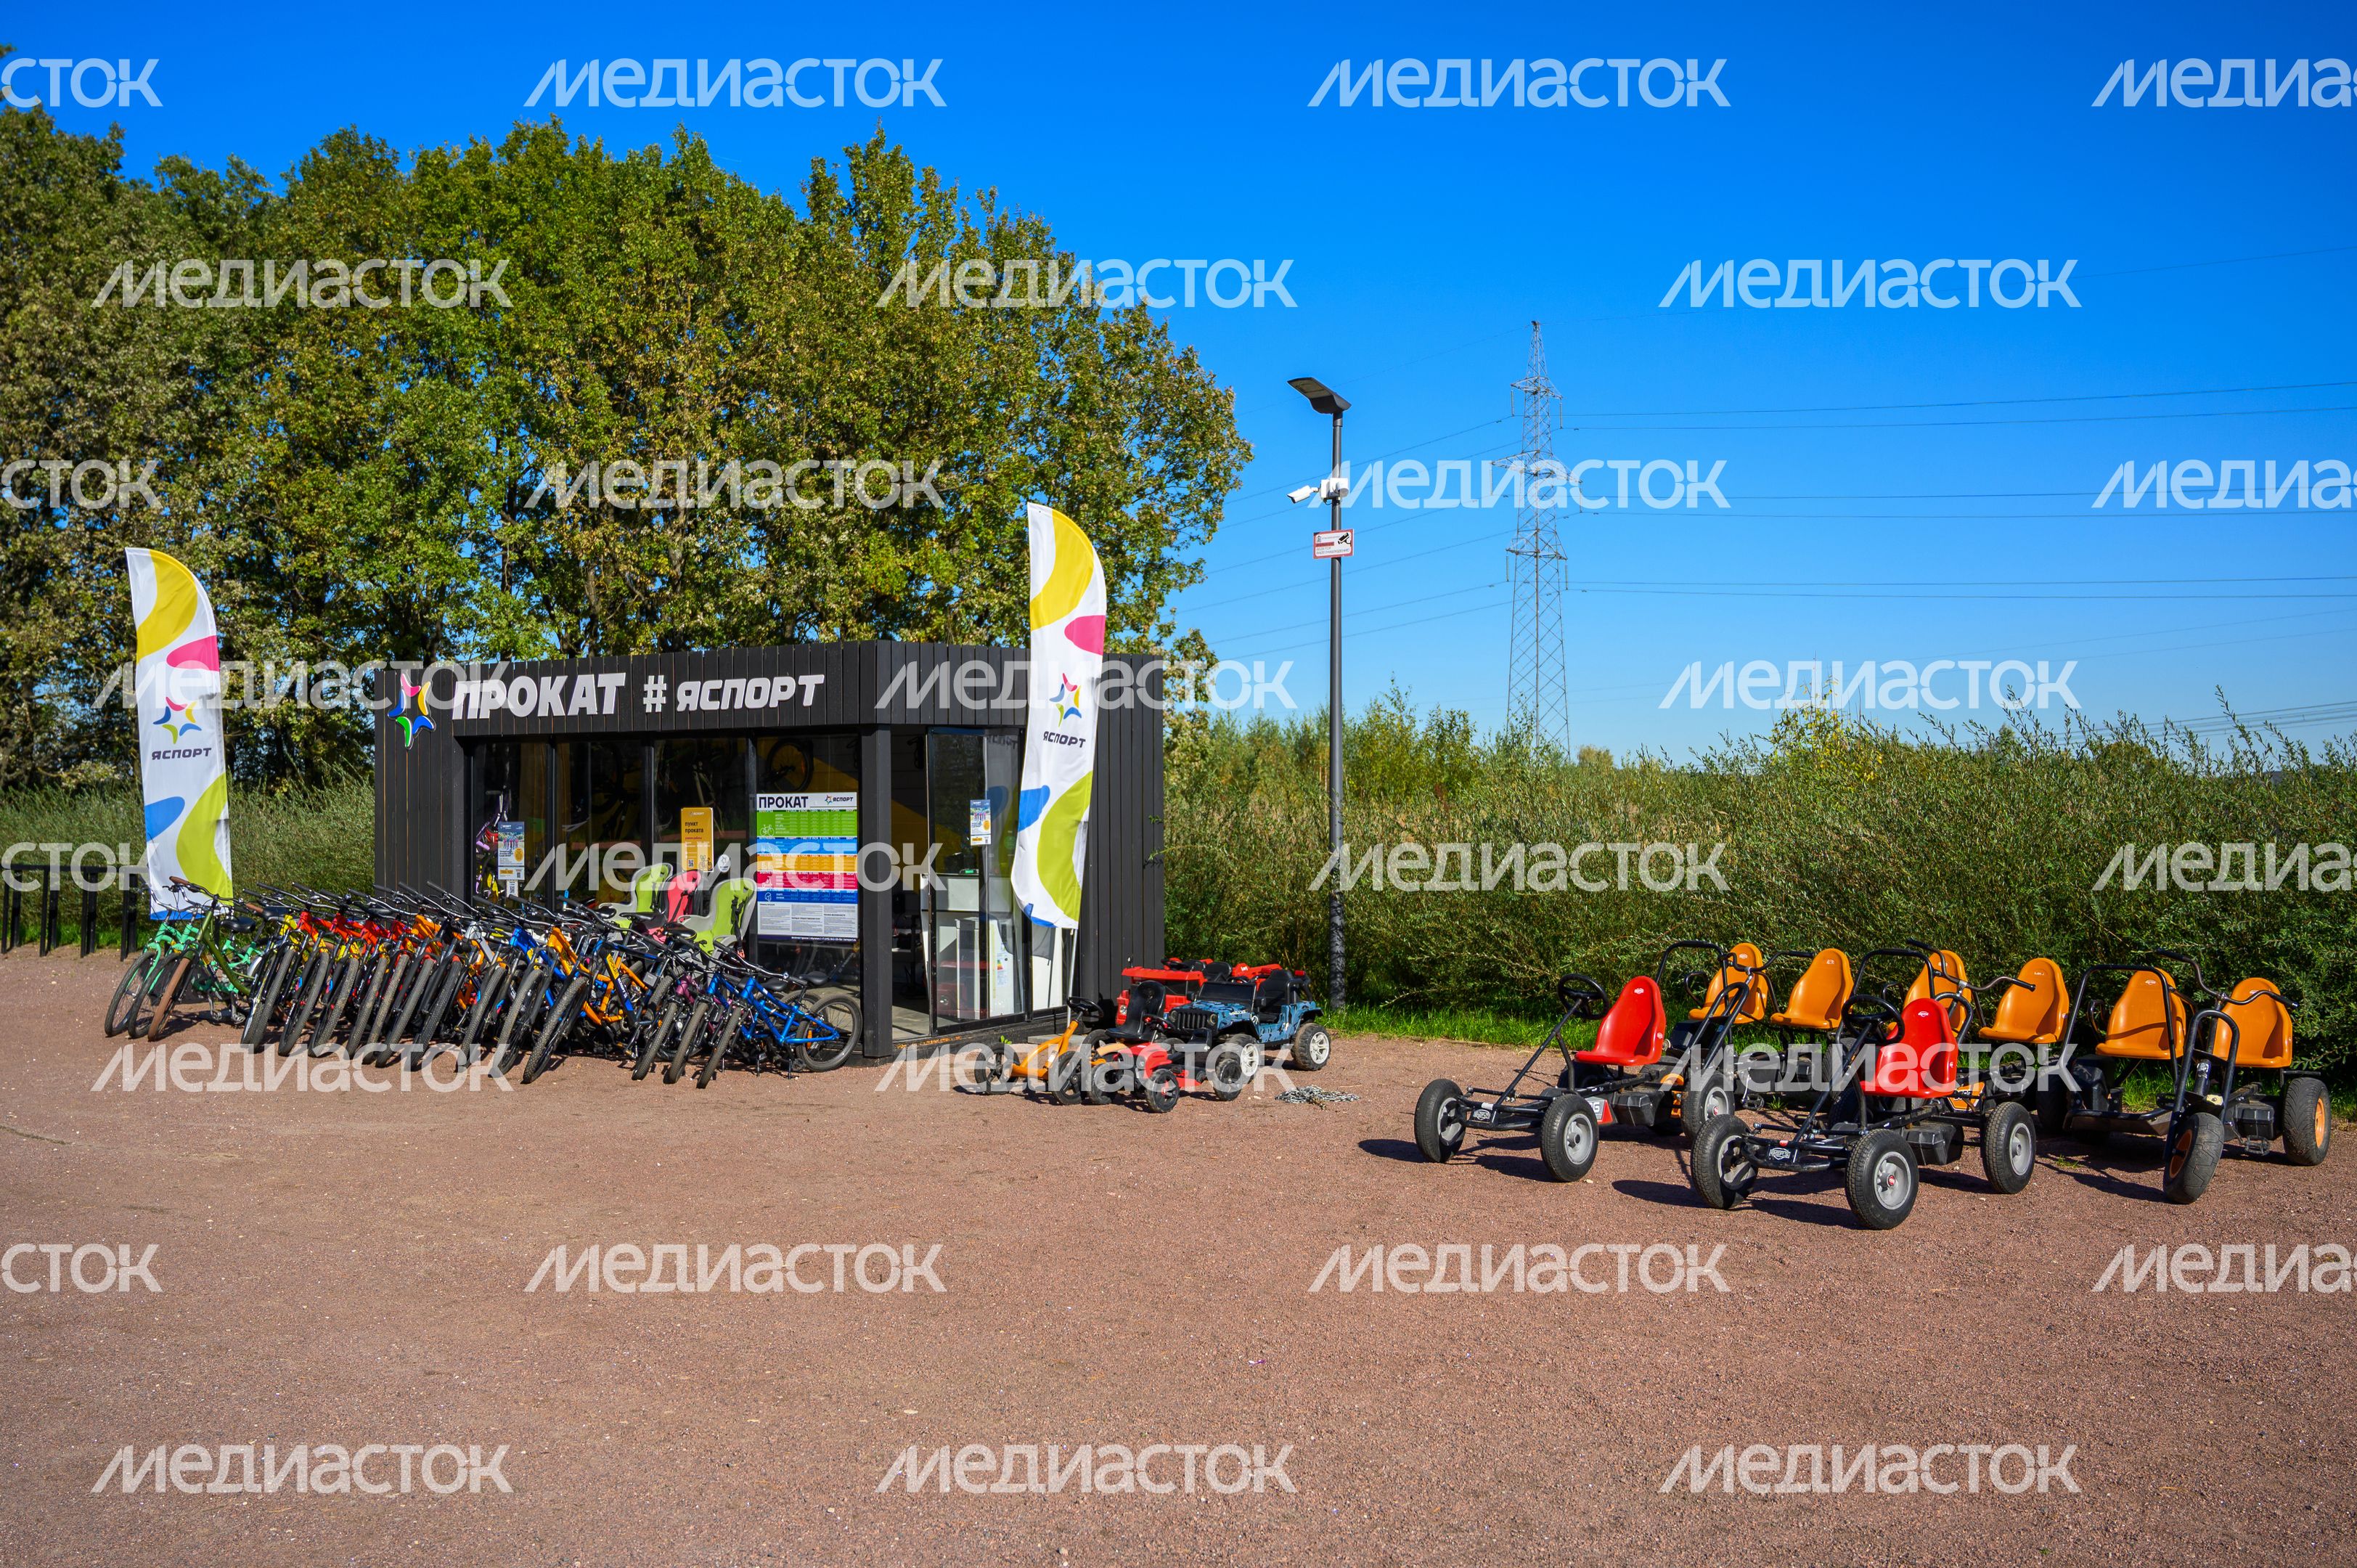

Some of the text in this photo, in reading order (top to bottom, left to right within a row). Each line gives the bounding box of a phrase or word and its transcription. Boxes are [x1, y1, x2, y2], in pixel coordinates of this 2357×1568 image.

[452, 672, 626, 720] ПРОКАТ
[1043, 730, 1086, 748] ЯСПОРТ
[151, 748, 212, 760] ЯСПОРТ
[759, 796, 809, 809] ПРОКАТ
